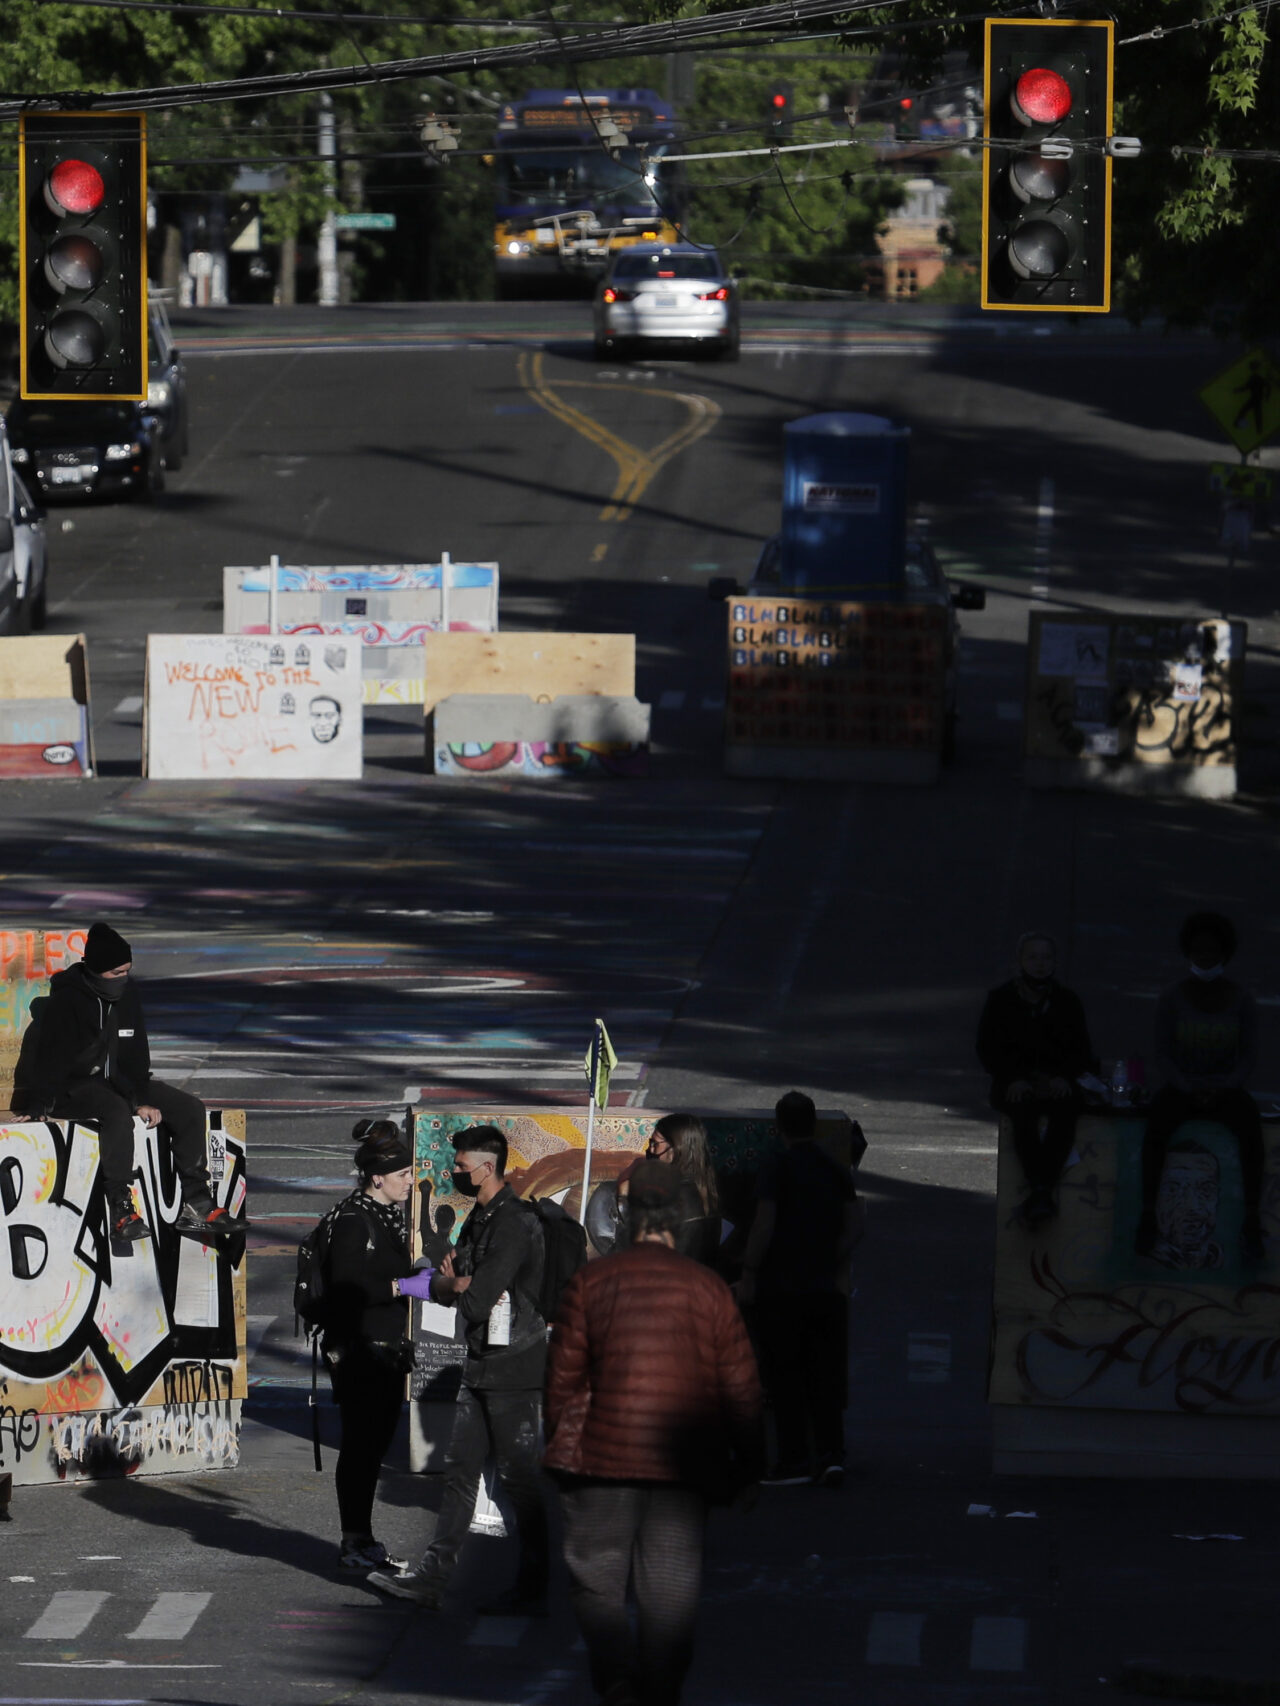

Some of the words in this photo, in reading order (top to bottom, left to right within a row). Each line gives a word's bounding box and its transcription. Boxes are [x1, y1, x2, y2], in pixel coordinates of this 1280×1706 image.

[164, 661, 250, 688] WELCOME
[254, 671, 277, 692] TO
[280, 667, 321, 686] THE
[188, 682, 263, 721] NEW
[12, 716, 64, 743] NOT
